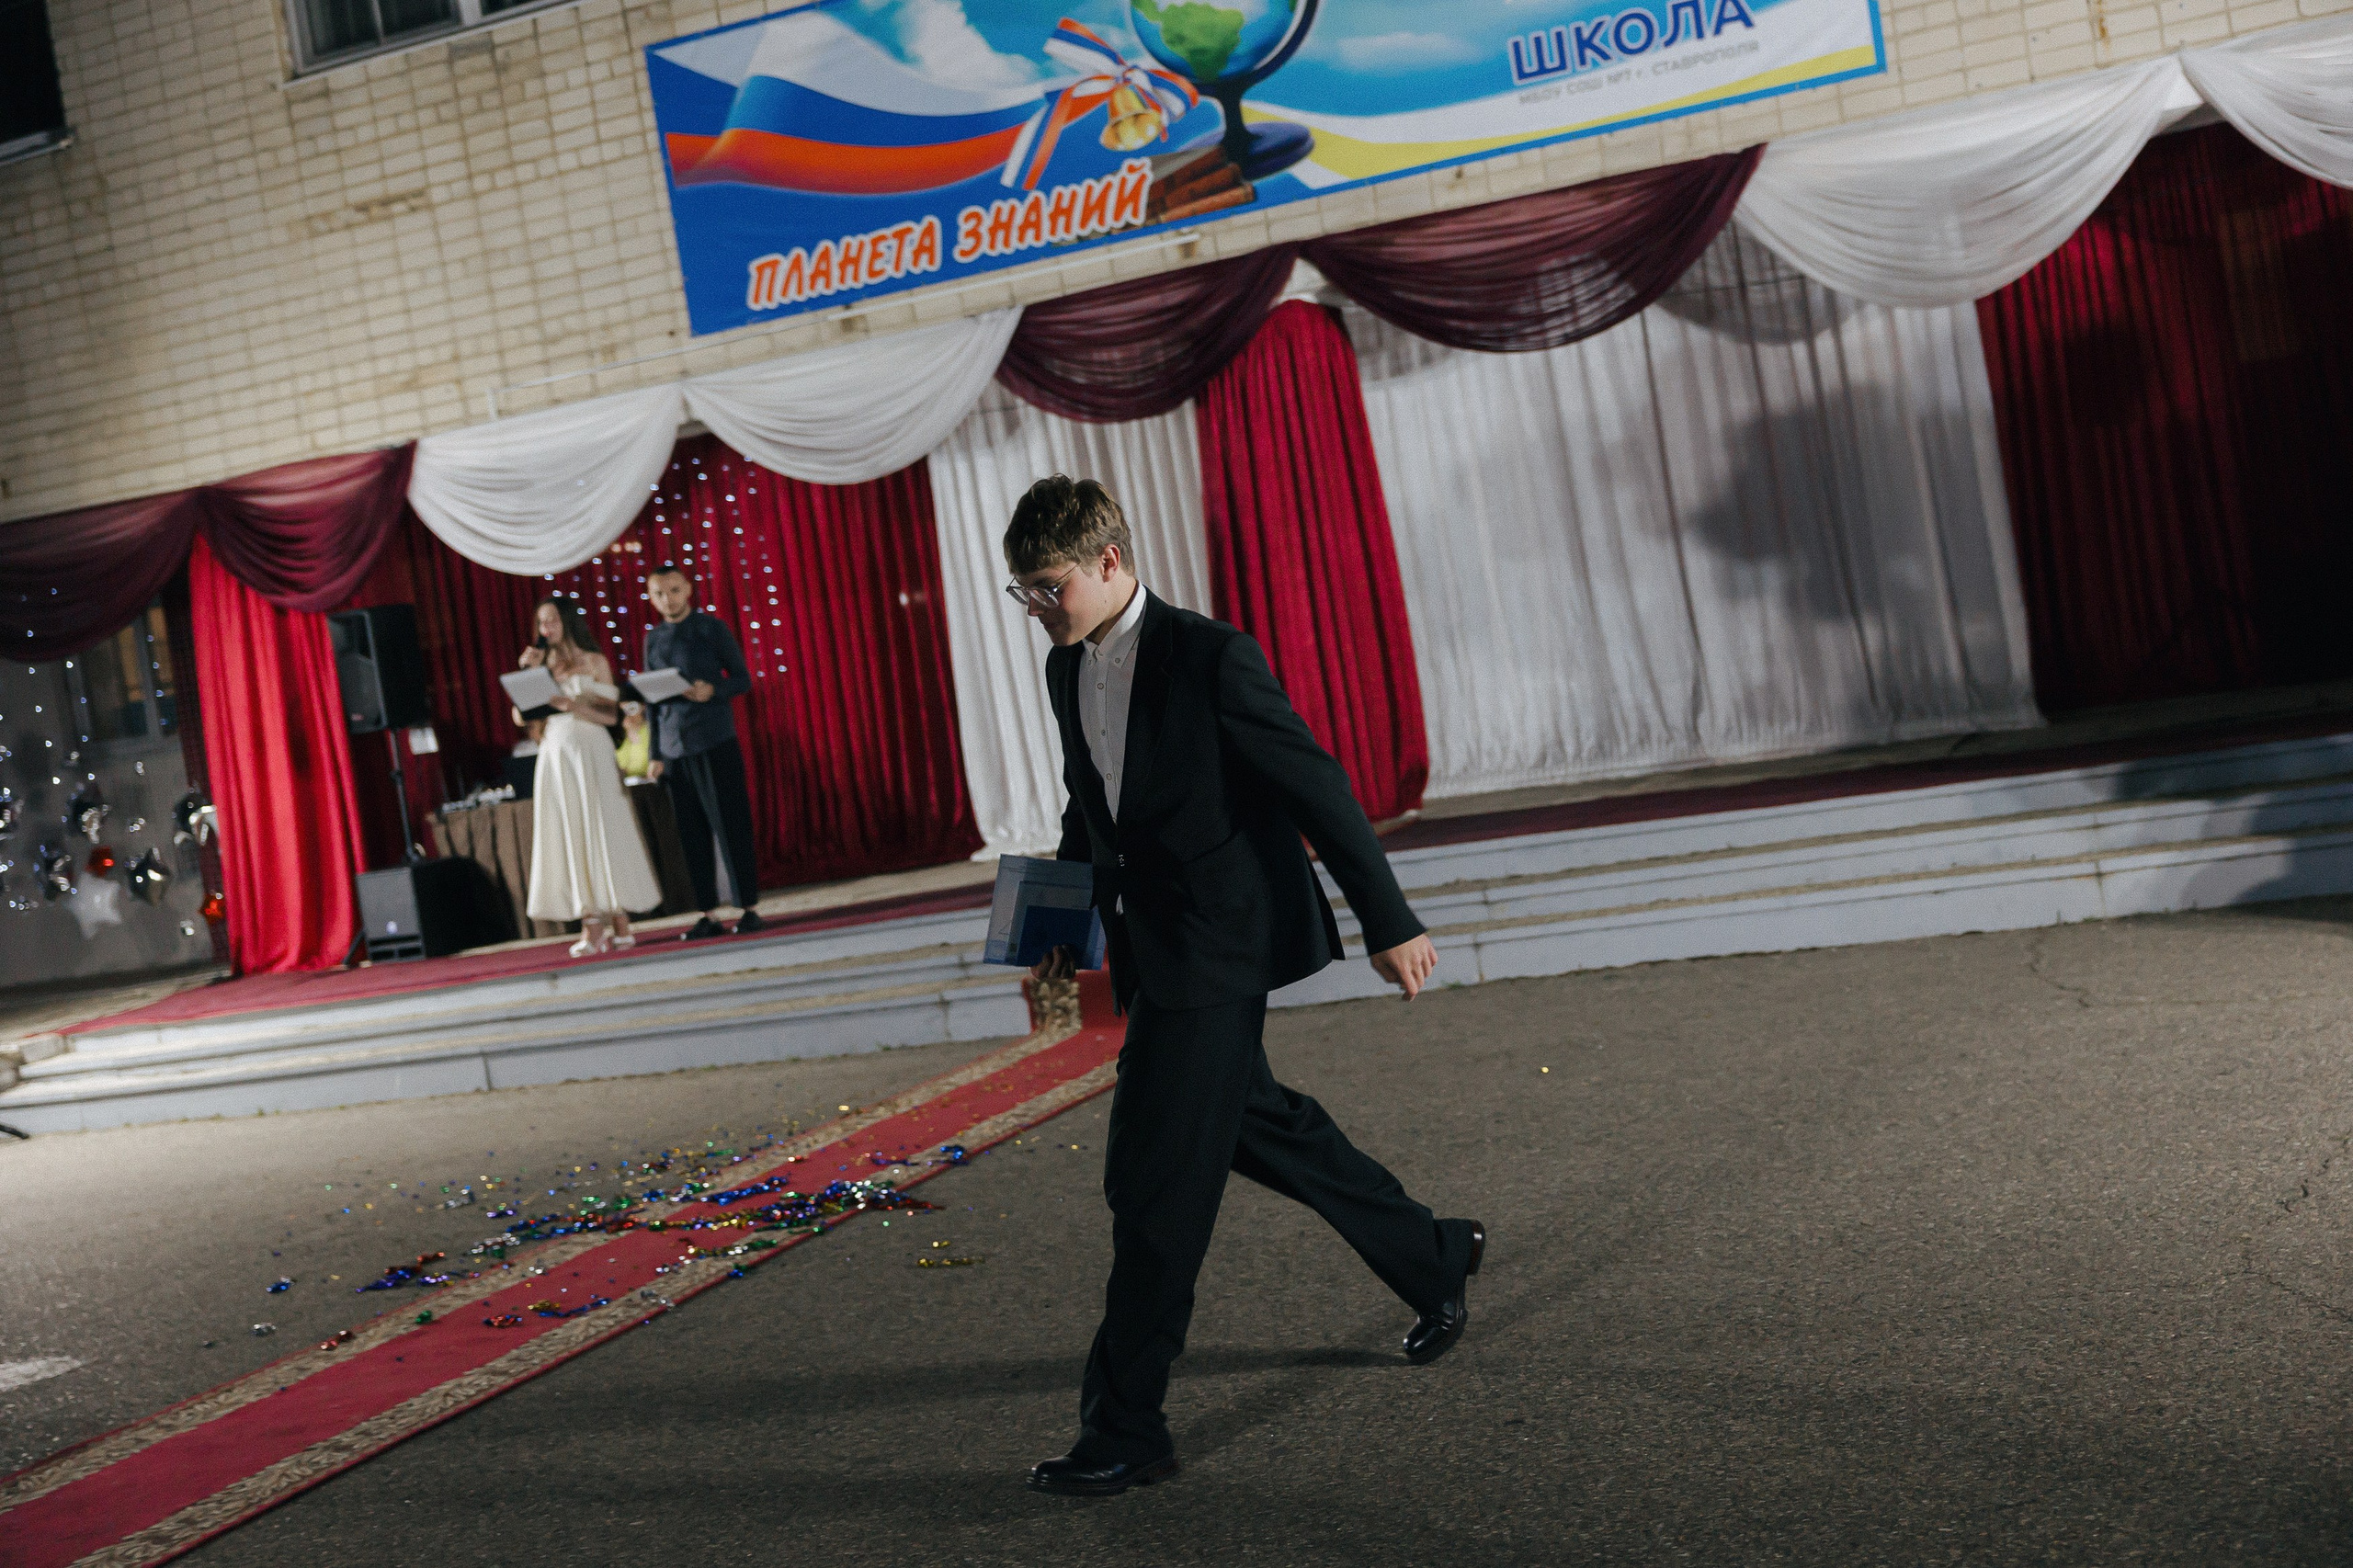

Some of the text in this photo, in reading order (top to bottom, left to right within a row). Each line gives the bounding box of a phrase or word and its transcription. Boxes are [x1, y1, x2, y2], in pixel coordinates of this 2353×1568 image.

[1512, 0, 1755, 81] ШКОЛА
[750, 160, 1151, 308] ПЛАНЕТА ЗНАНИЙ
